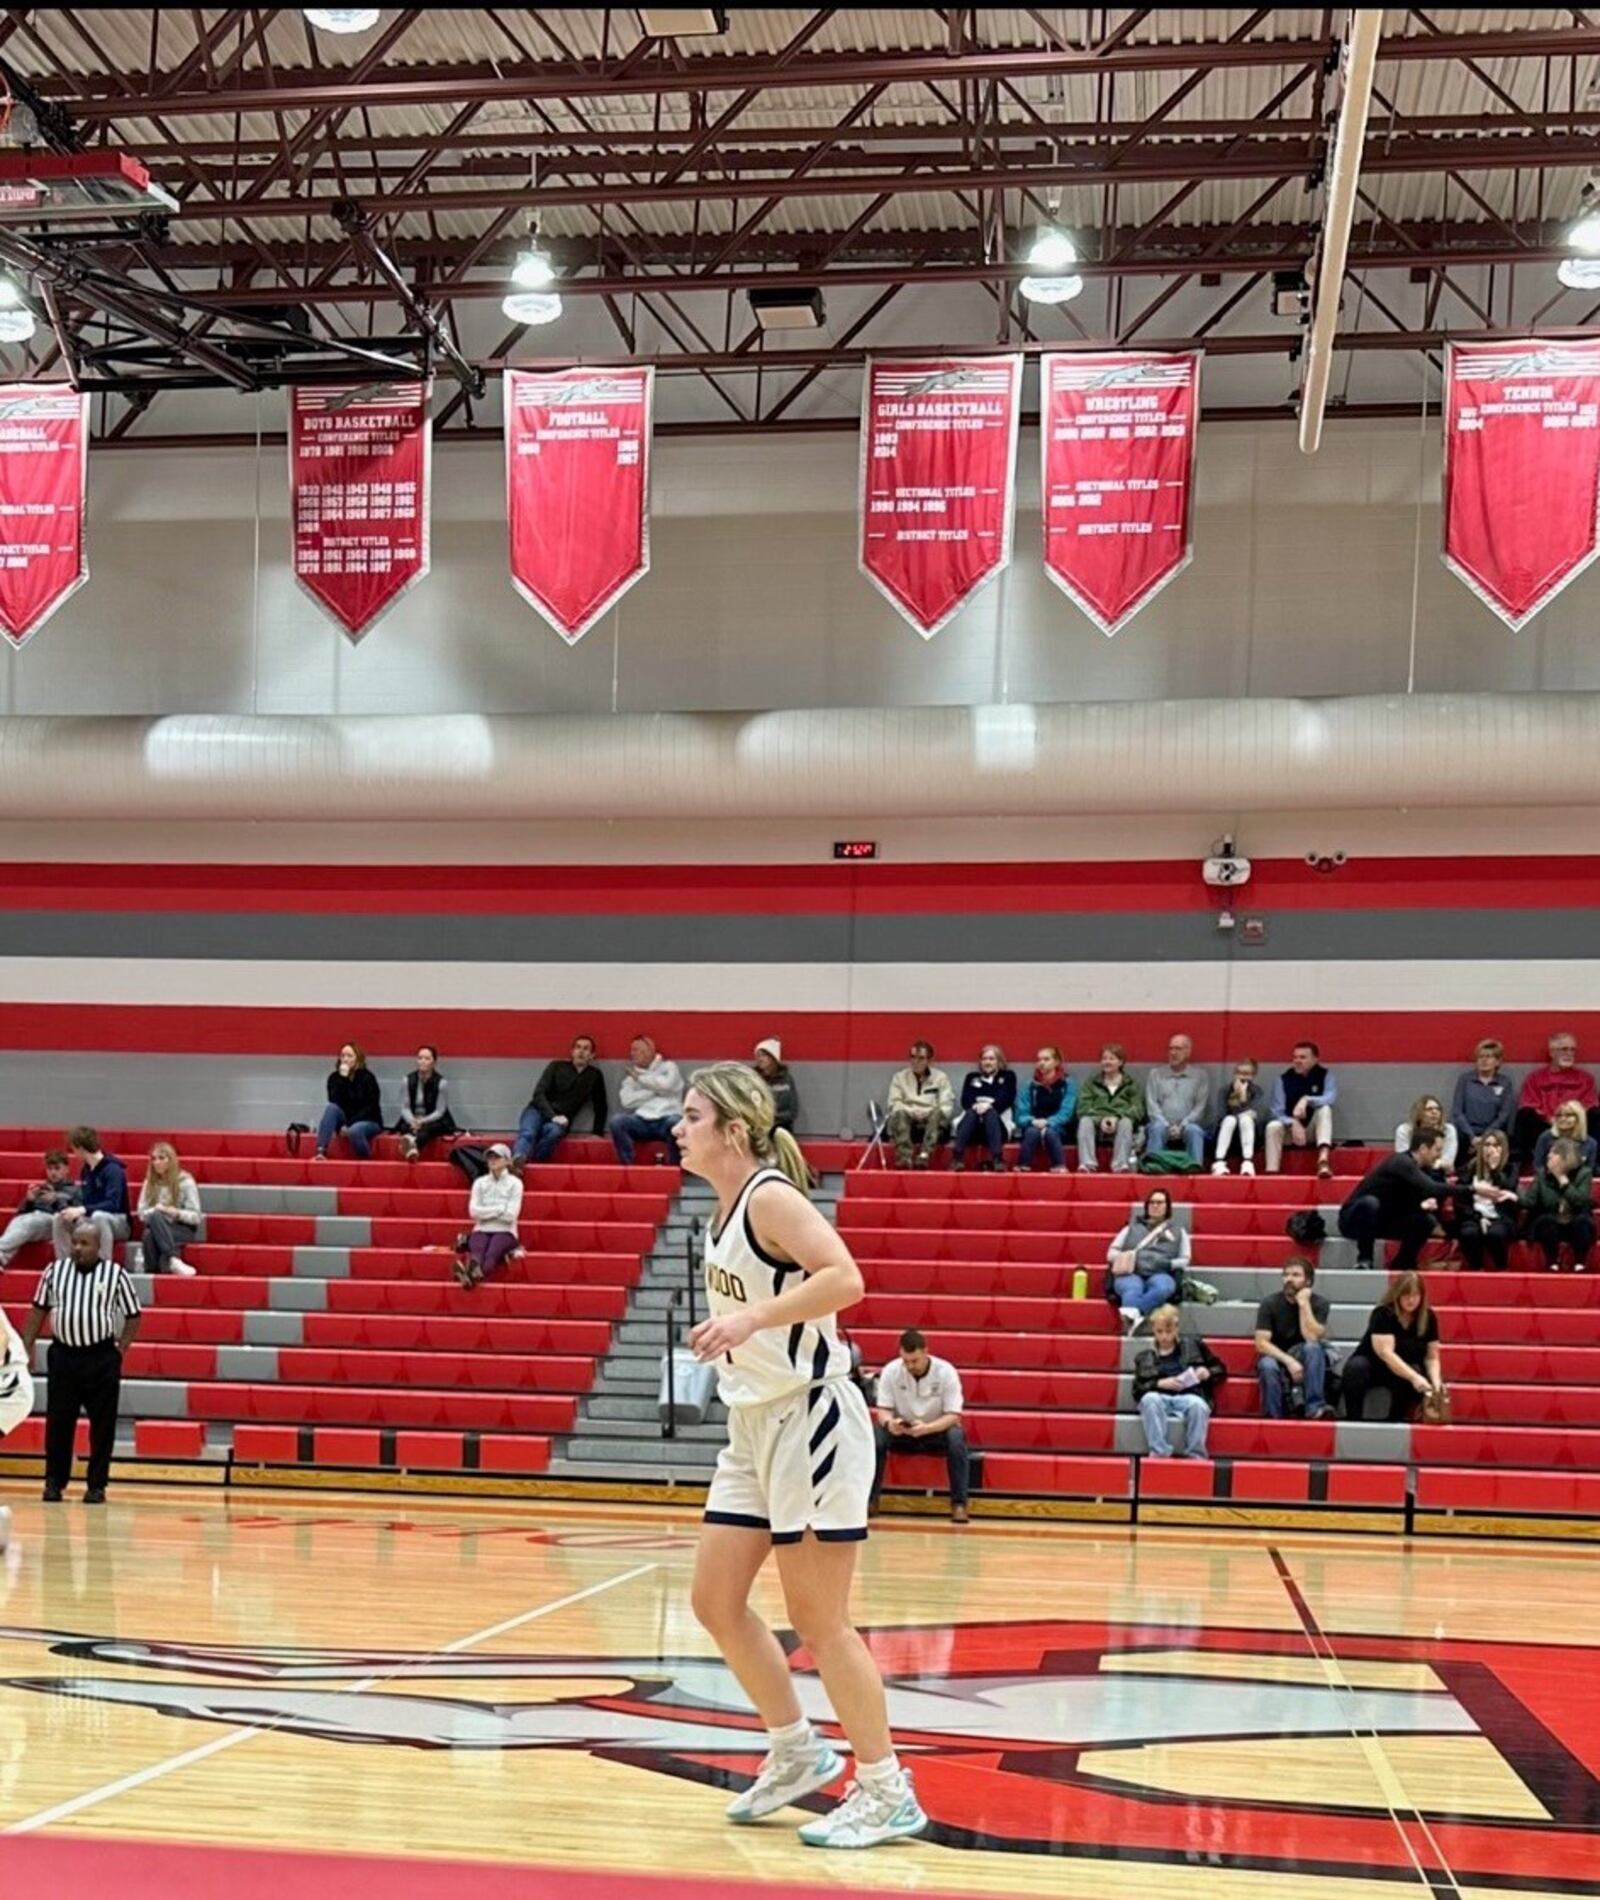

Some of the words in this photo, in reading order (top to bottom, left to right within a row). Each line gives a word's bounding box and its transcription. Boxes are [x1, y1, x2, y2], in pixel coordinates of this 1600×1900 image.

[1503, 385, 1553, 400] TENNIS
[877, 403, 915, 417] GIRLS
[916, 401, 1003, 416] BASKETBALL
[1085, 395, 1159, 411] WRESTLING
[1479, 403, 1541, 414] CONFERENCE
[1543, 401, 1577, 413] TITLES
[303, 416, 333, 430] BOYS
[335, 414, 416, 429] BASKETBALL
[549, 411, 609, 426] FOOTBALL
[895, 419, 950, 430] CONFERENCE
[953, 419, 983, 429] TITLES
[1075, 413, 1133, 425] CONFERENCE
[1134, 412, 1167, 423] TITLES
[318, 432, 369, 443] CONFERENCE
[371, 431, 400, 441] TITLES
[536, 429, 588, 440] CONFERENCE
[590, 428, 620, 439] TITLES
[895, 487, 943, 498] SECTIONAL
[944, 486, 976, 497] TITLES
[1075, 481, 1126, 492] SECTIONAL
[1127, 479, 1159, 490] TITLES
[896, 529, 937, 541] DISTRICT
[938, 529, 968, 540] TITLES
[1077, 523, 1119, 535] DISTRICT
[1120, 522, 1153, 533] TITLES
[323, 536, 359, 547] DISTRICT
[361, 536, 389, 546] TITLES
